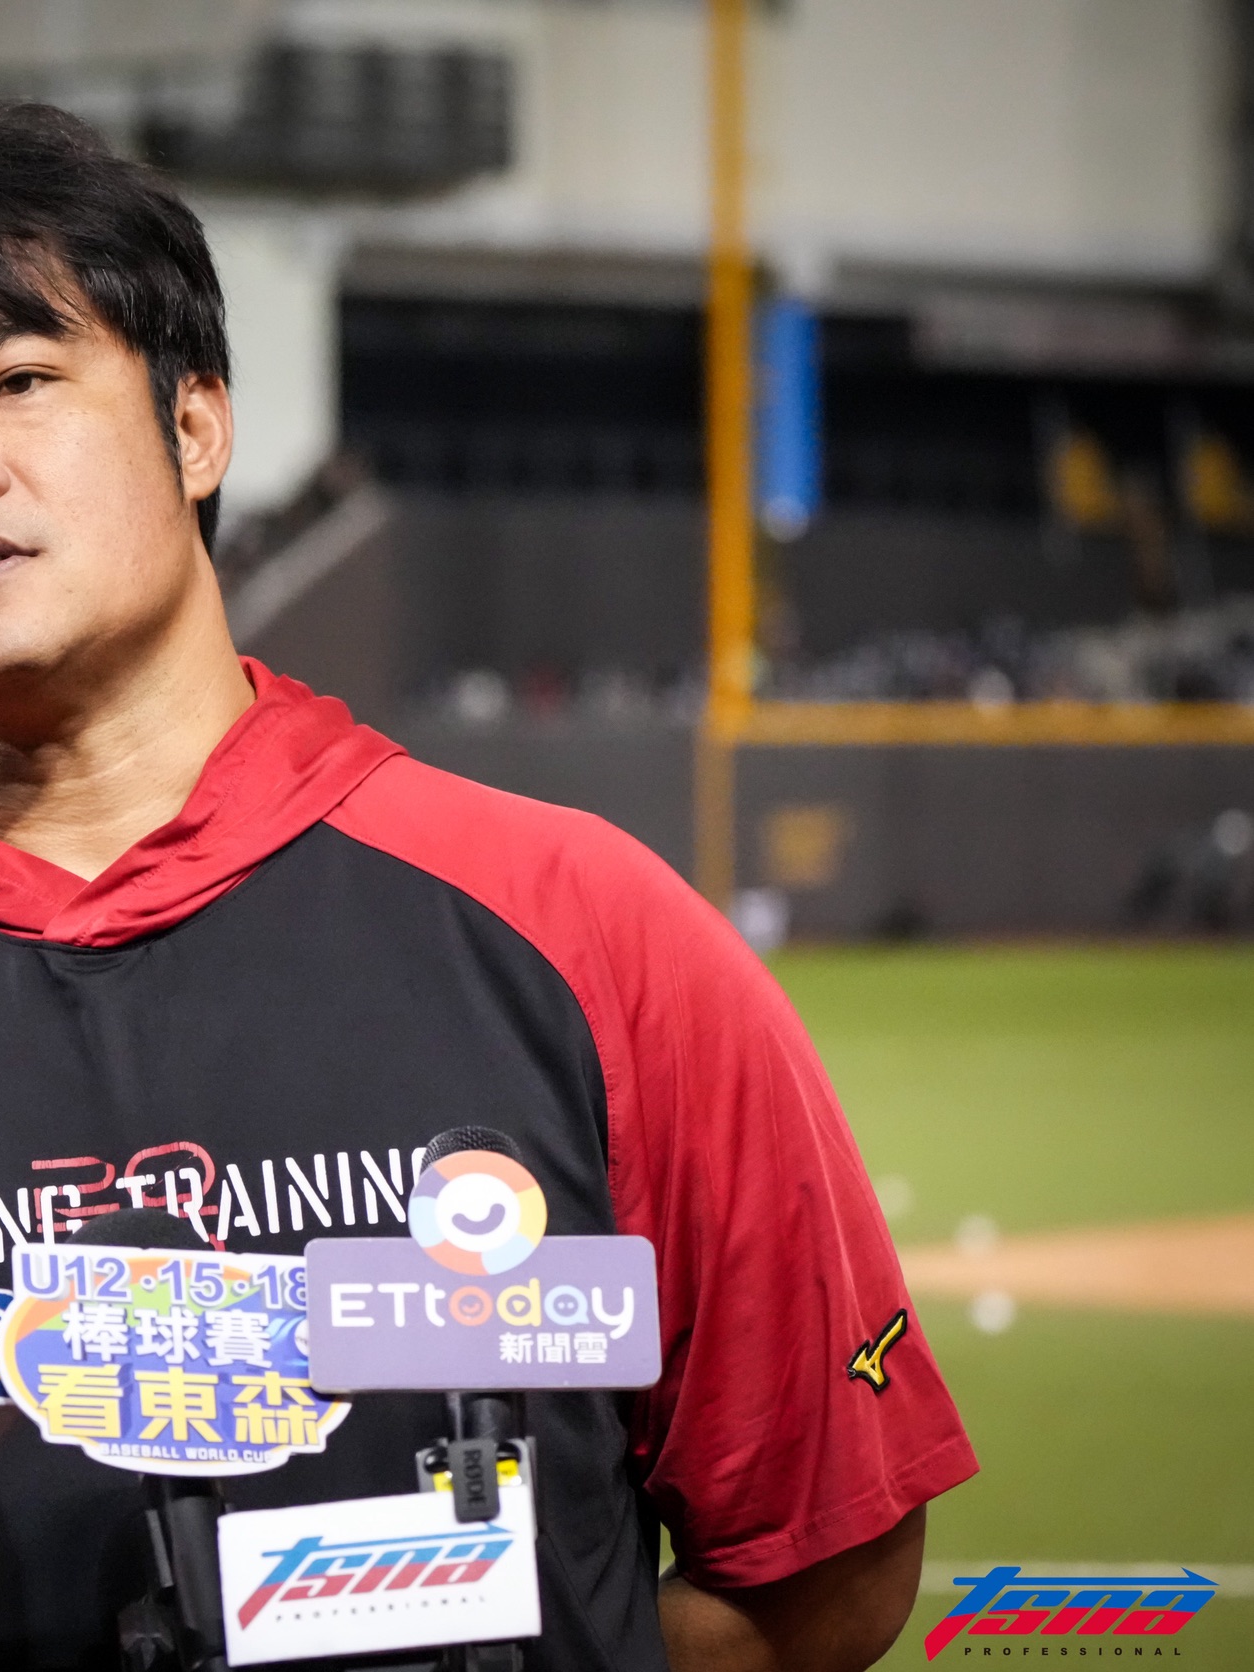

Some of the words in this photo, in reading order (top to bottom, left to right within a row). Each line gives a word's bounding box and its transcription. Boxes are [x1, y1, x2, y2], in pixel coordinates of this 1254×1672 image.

[61, 1302, 274, 1369] 棒球賽
[330, 1277, 635, 1341] ETtoday
[498, 1331, 609, 1365] 新聞雲
[37, 1362, 319, 1446] 看東森
[99, 1442, 180, 1460] BASEBALL
[184, 1446, 239, 1462] WORLD
